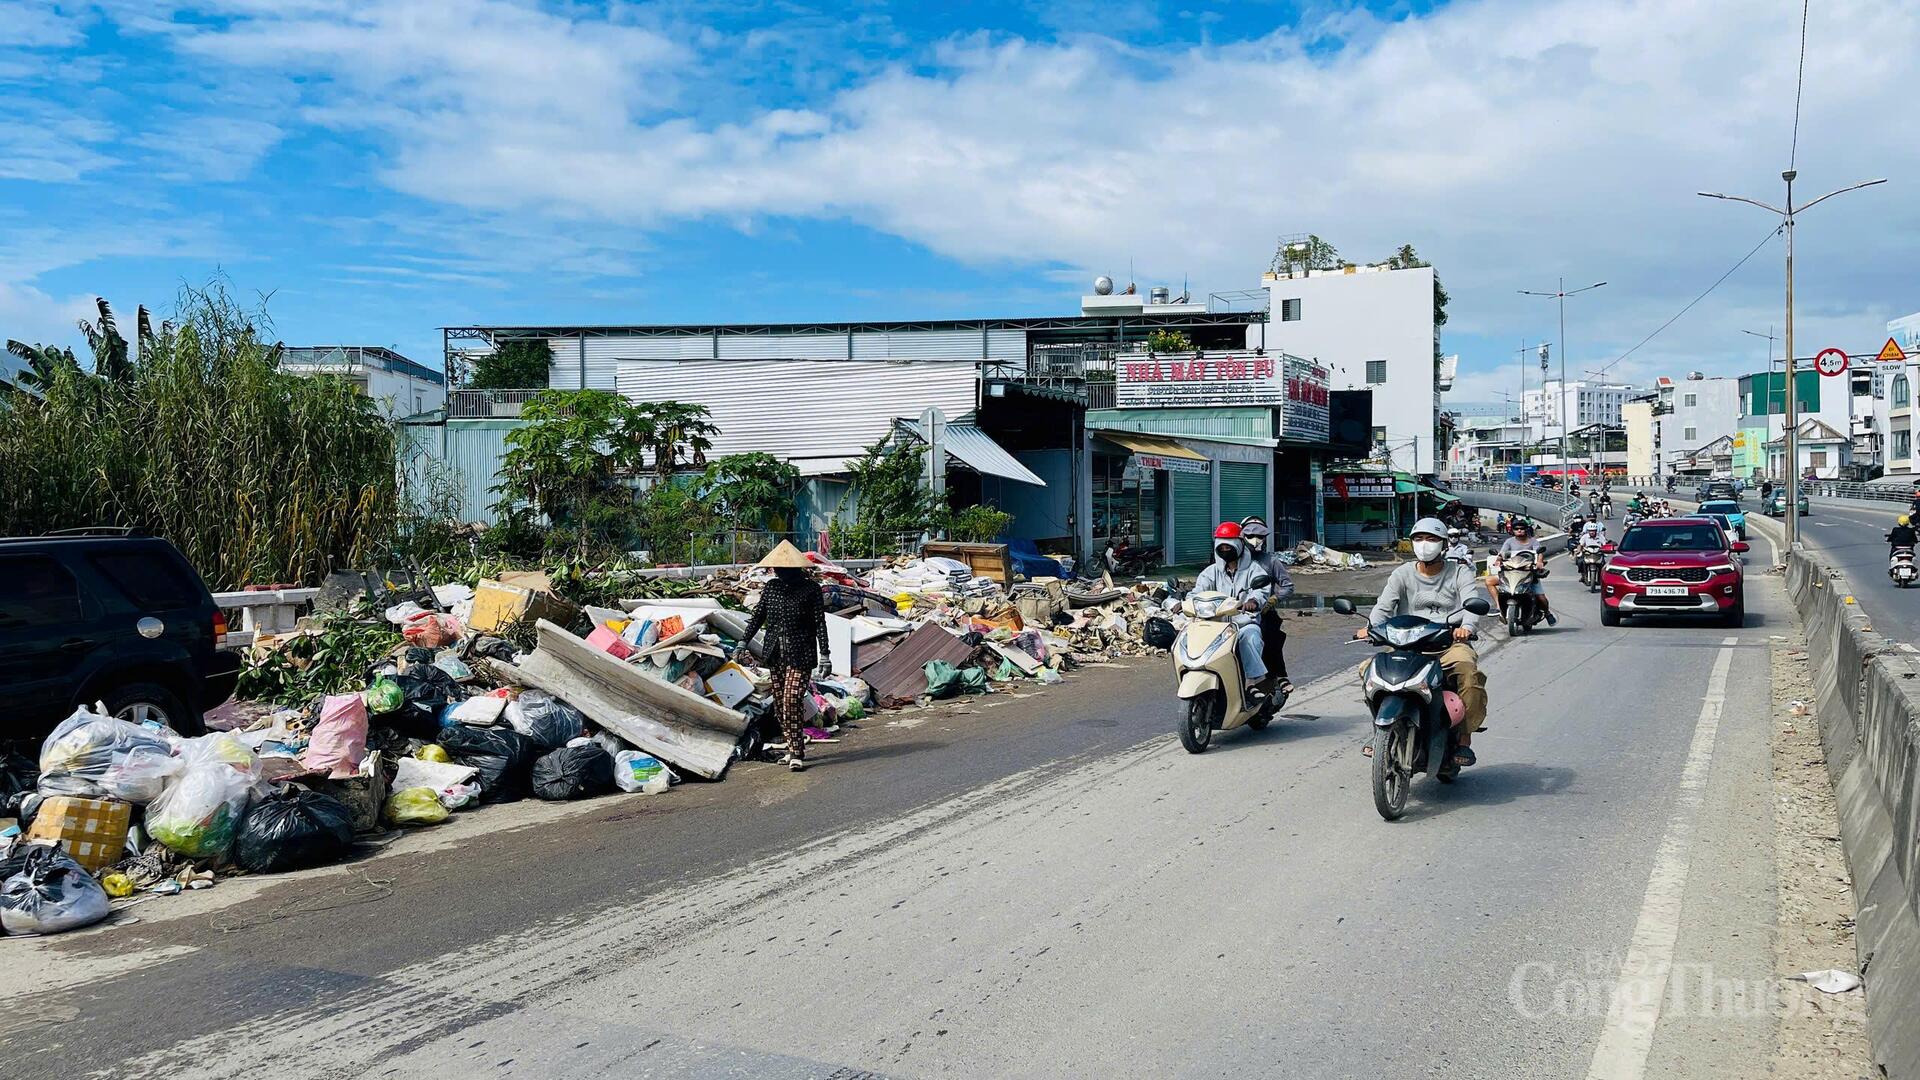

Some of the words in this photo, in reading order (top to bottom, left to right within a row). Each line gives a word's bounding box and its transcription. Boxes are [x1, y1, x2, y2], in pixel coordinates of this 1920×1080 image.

[1125, 357, 1163, 382] NHÀ
[1170, 355, 1207, 381] MÁY
[1214, 355, 1246, 380] TÔN
[1253, 359, 1274, 379] PU
